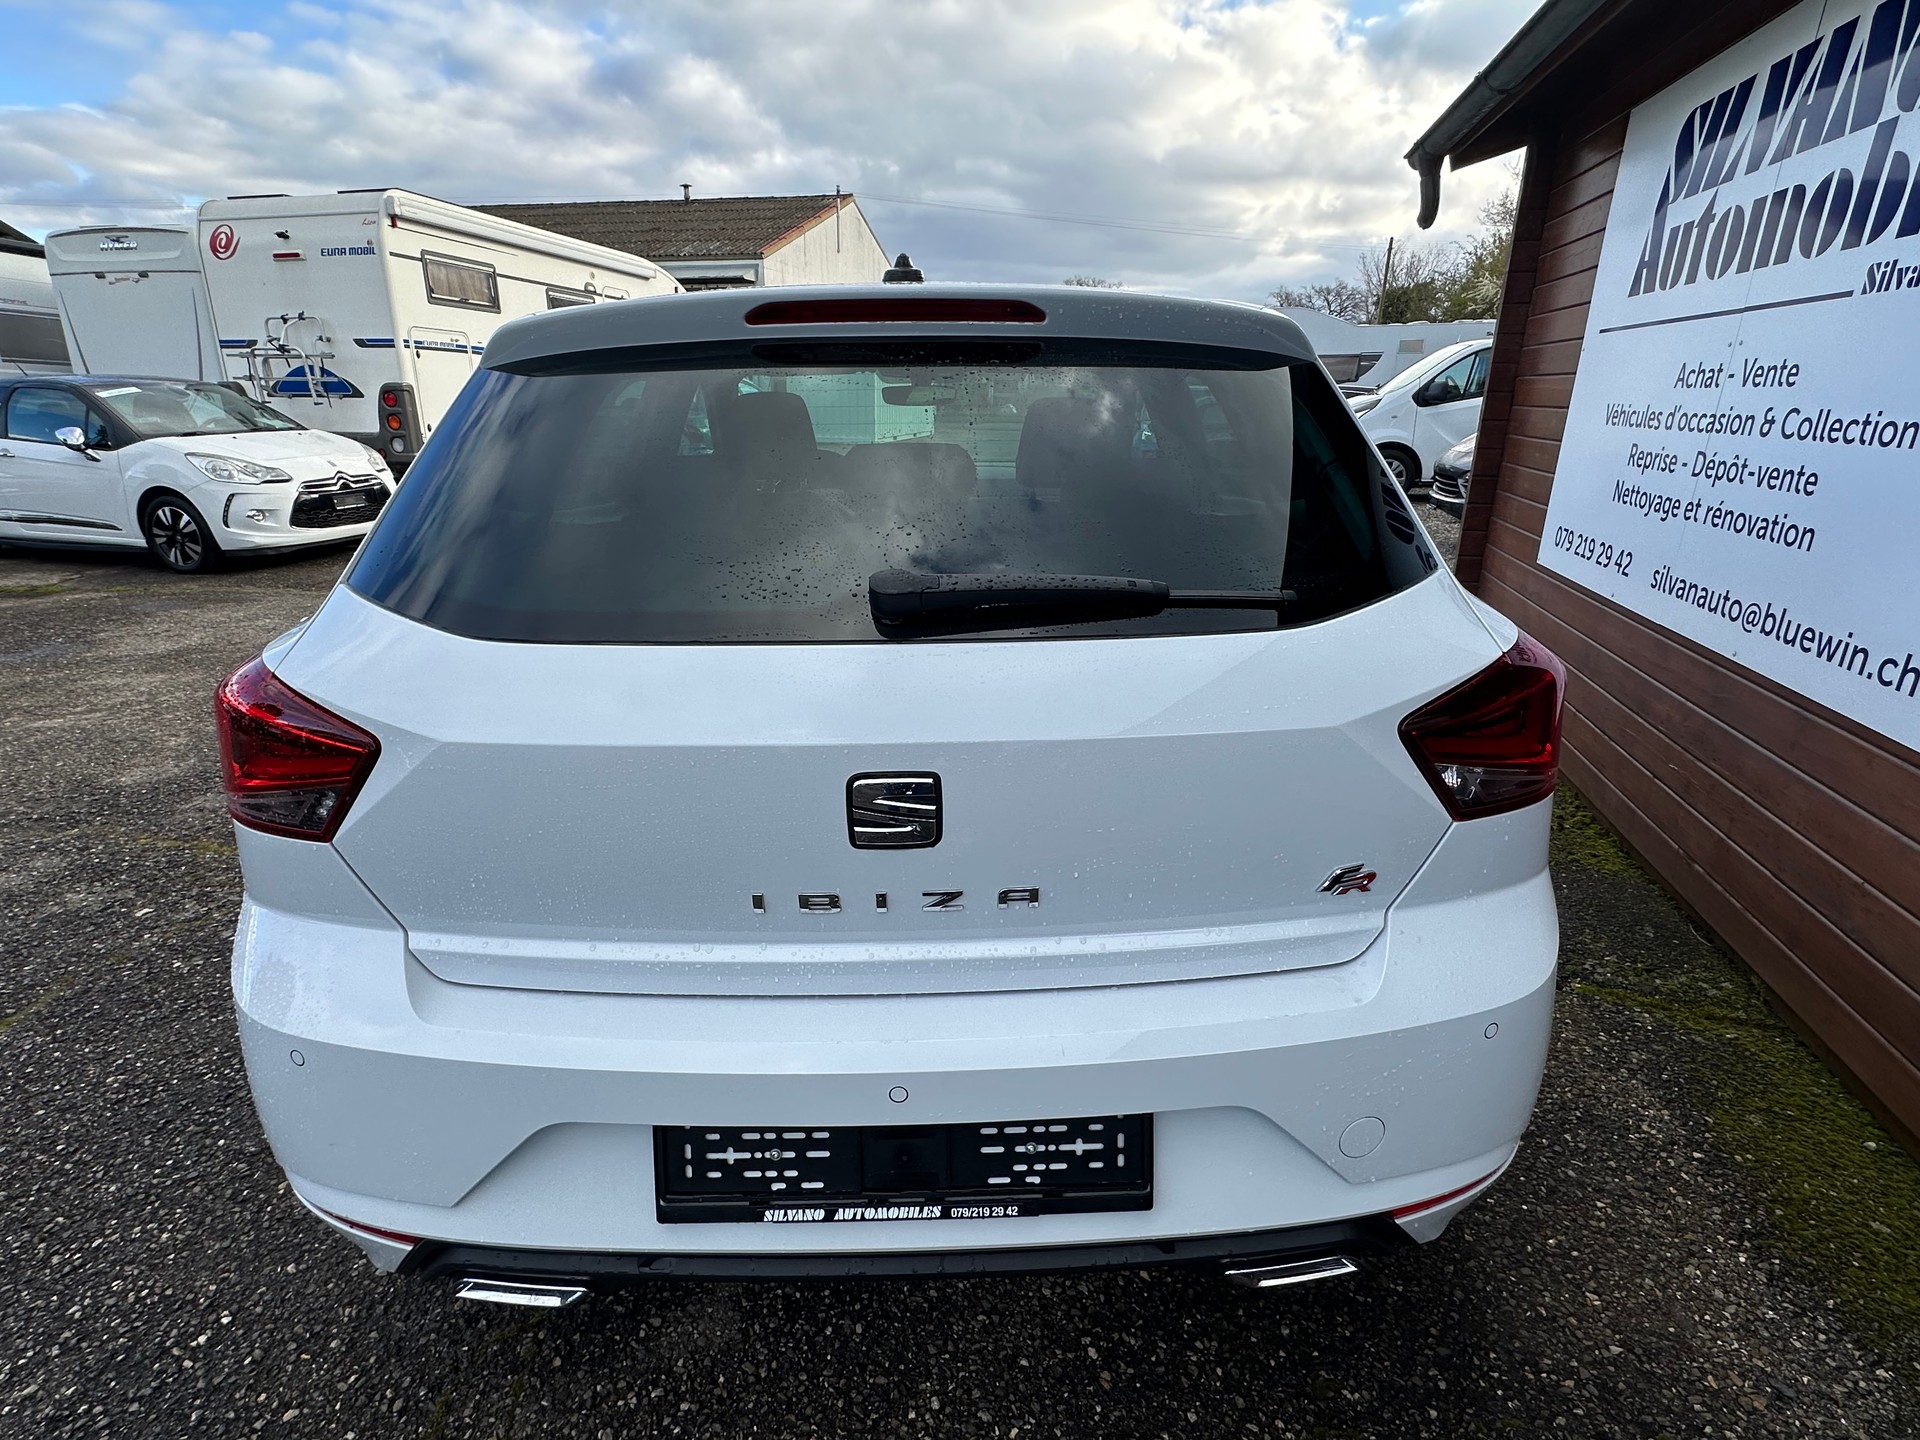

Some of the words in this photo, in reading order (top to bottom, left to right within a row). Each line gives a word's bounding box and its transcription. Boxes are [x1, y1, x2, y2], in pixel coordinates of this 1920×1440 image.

[320, 247, 347, 257] EURA
[348, 246, 377, 256] MOBIL
[1673, 361, 1724, 389] Achat
[1741, 358, 1800, 388] Vente
[1605, 403, 1664, 431] Véhicules
[1664, 404, 1756, 437] d'occasion
[1760, 406, 1777, 438] &
[1780, 408, 1920, 450] Collection
[1627, 442, 1678, 475] Reprise
[1691, 450, 1819, 497] Dépôt-vente
[1612, 479, 1681, 523] Nettoyage
[1683, 497, 1702, 523] et
[1702, 500, 1816, 553] rénovation
[1554, 525, 1575, 552] 079
[1573, 533, 1597, 562] 219
[1595, 541, 1613, 569] 29
[1613, 549, 1634, 578] 42
[1650, 564, 1920, 698] silvanauto@bluewin.ch
[751, 886, 1040, 914] IBIZA
[763, 1208, 825, 1222] SILVANO
[833, 1205, 942, 1221] AUTOMOBILES
[950, 1206, 990, 1218] 079/219
[991, 1206, 1004, 1217] 29
[1005, 1205, 1019, 1216] 42
